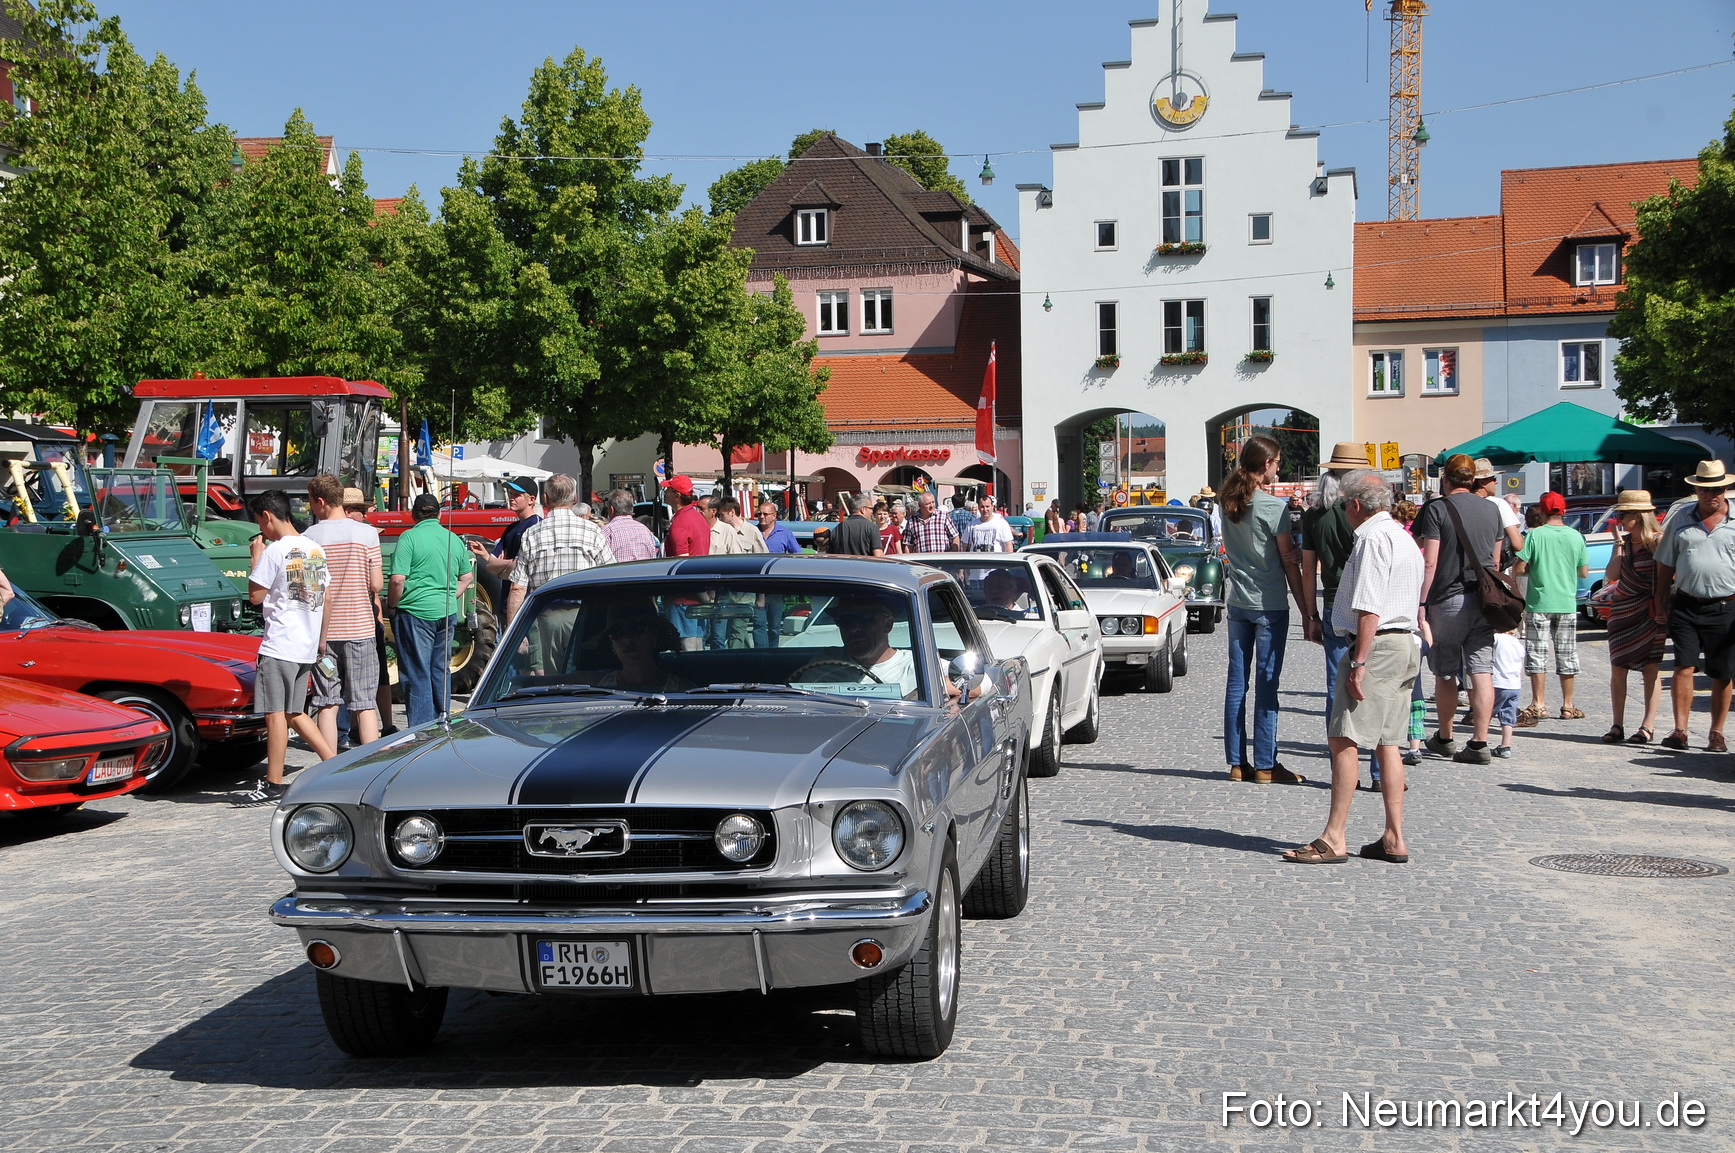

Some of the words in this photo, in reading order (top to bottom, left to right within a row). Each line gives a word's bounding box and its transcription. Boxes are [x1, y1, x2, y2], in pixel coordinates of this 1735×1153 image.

[453, 447, 460, 457] P
[859, 446, 951, 465] Sparkasse
[95, 761, 113, 779] LAU
[543, 953, 550, 961] D
[558, 943, 588, 964] RH
[541, 965, 629, 985] F1966H
